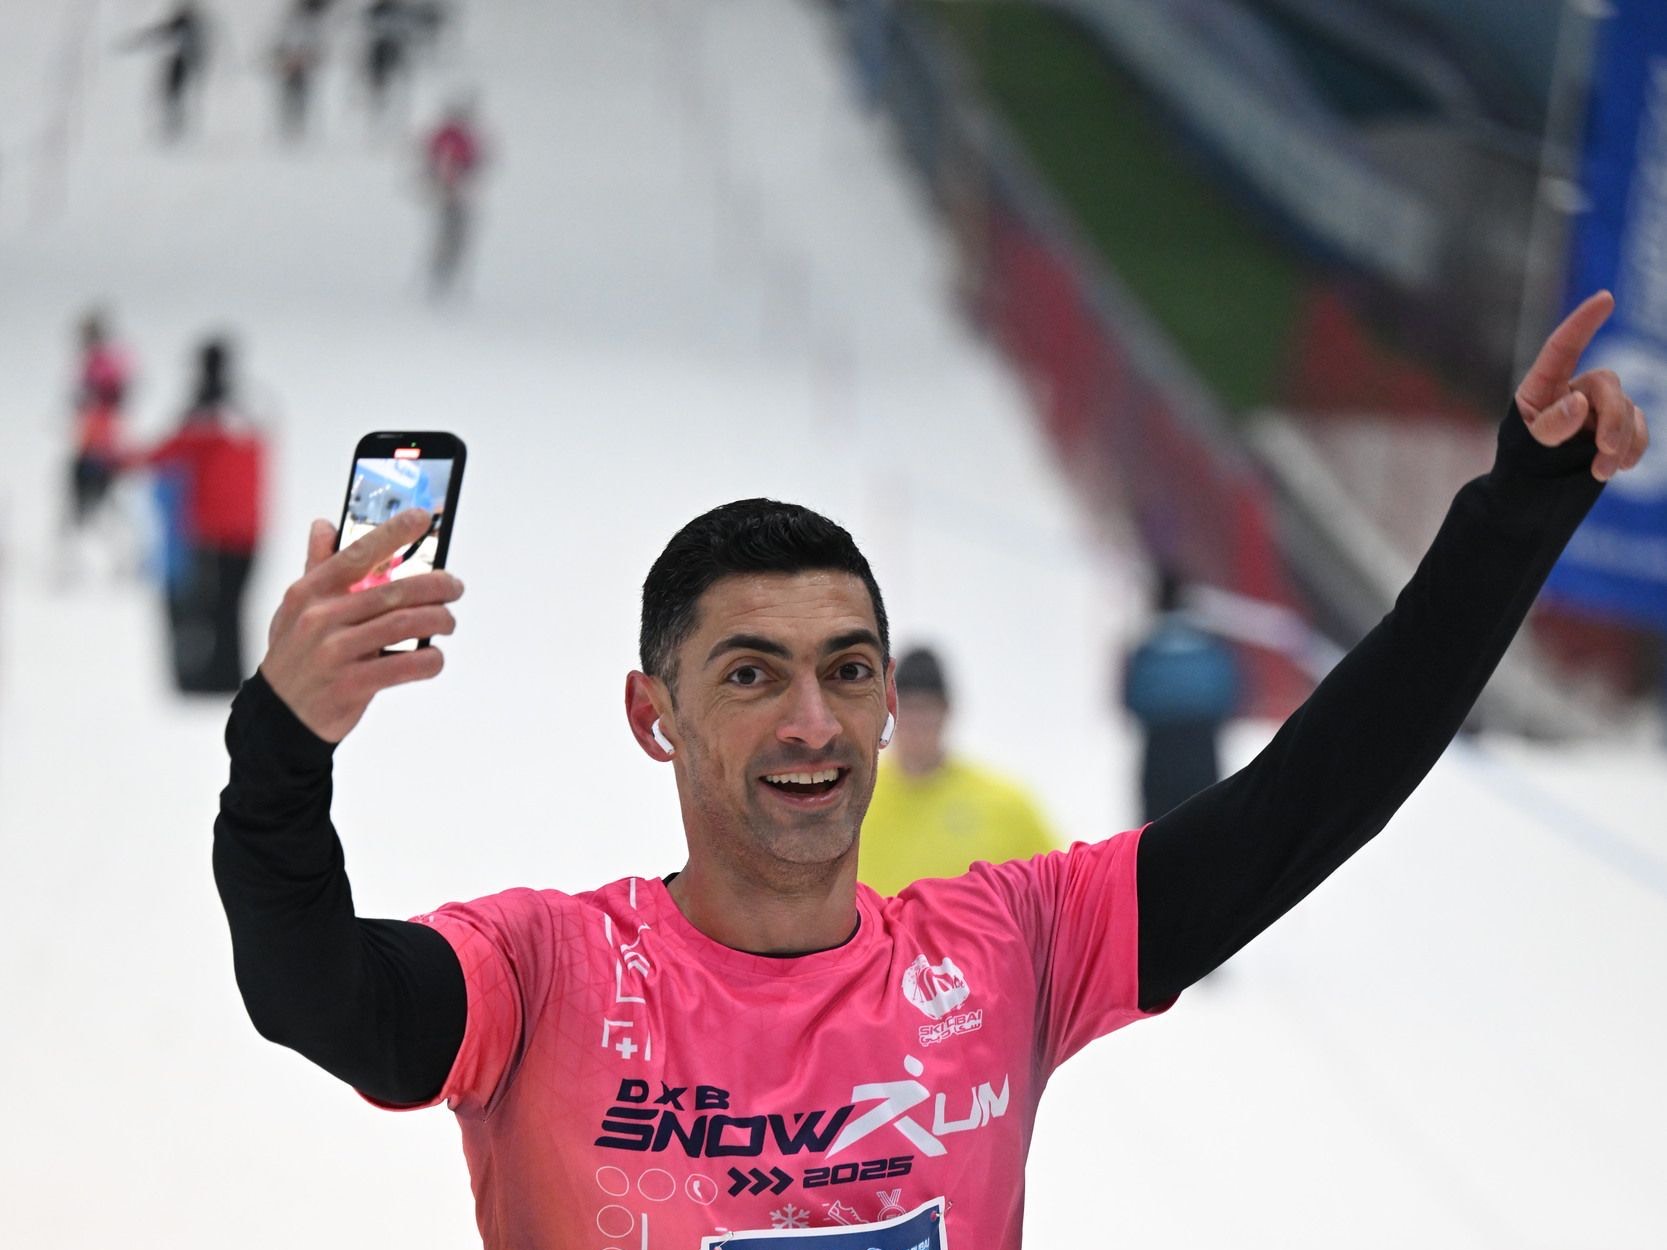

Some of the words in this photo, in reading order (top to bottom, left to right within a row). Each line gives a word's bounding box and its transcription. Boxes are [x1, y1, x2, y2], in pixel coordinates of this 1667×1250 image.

[919, 1023, 945, 1036] SKI
[594, 1104, 857, 1159] SNOW
[803, 1155, 915, 1189] 2025
